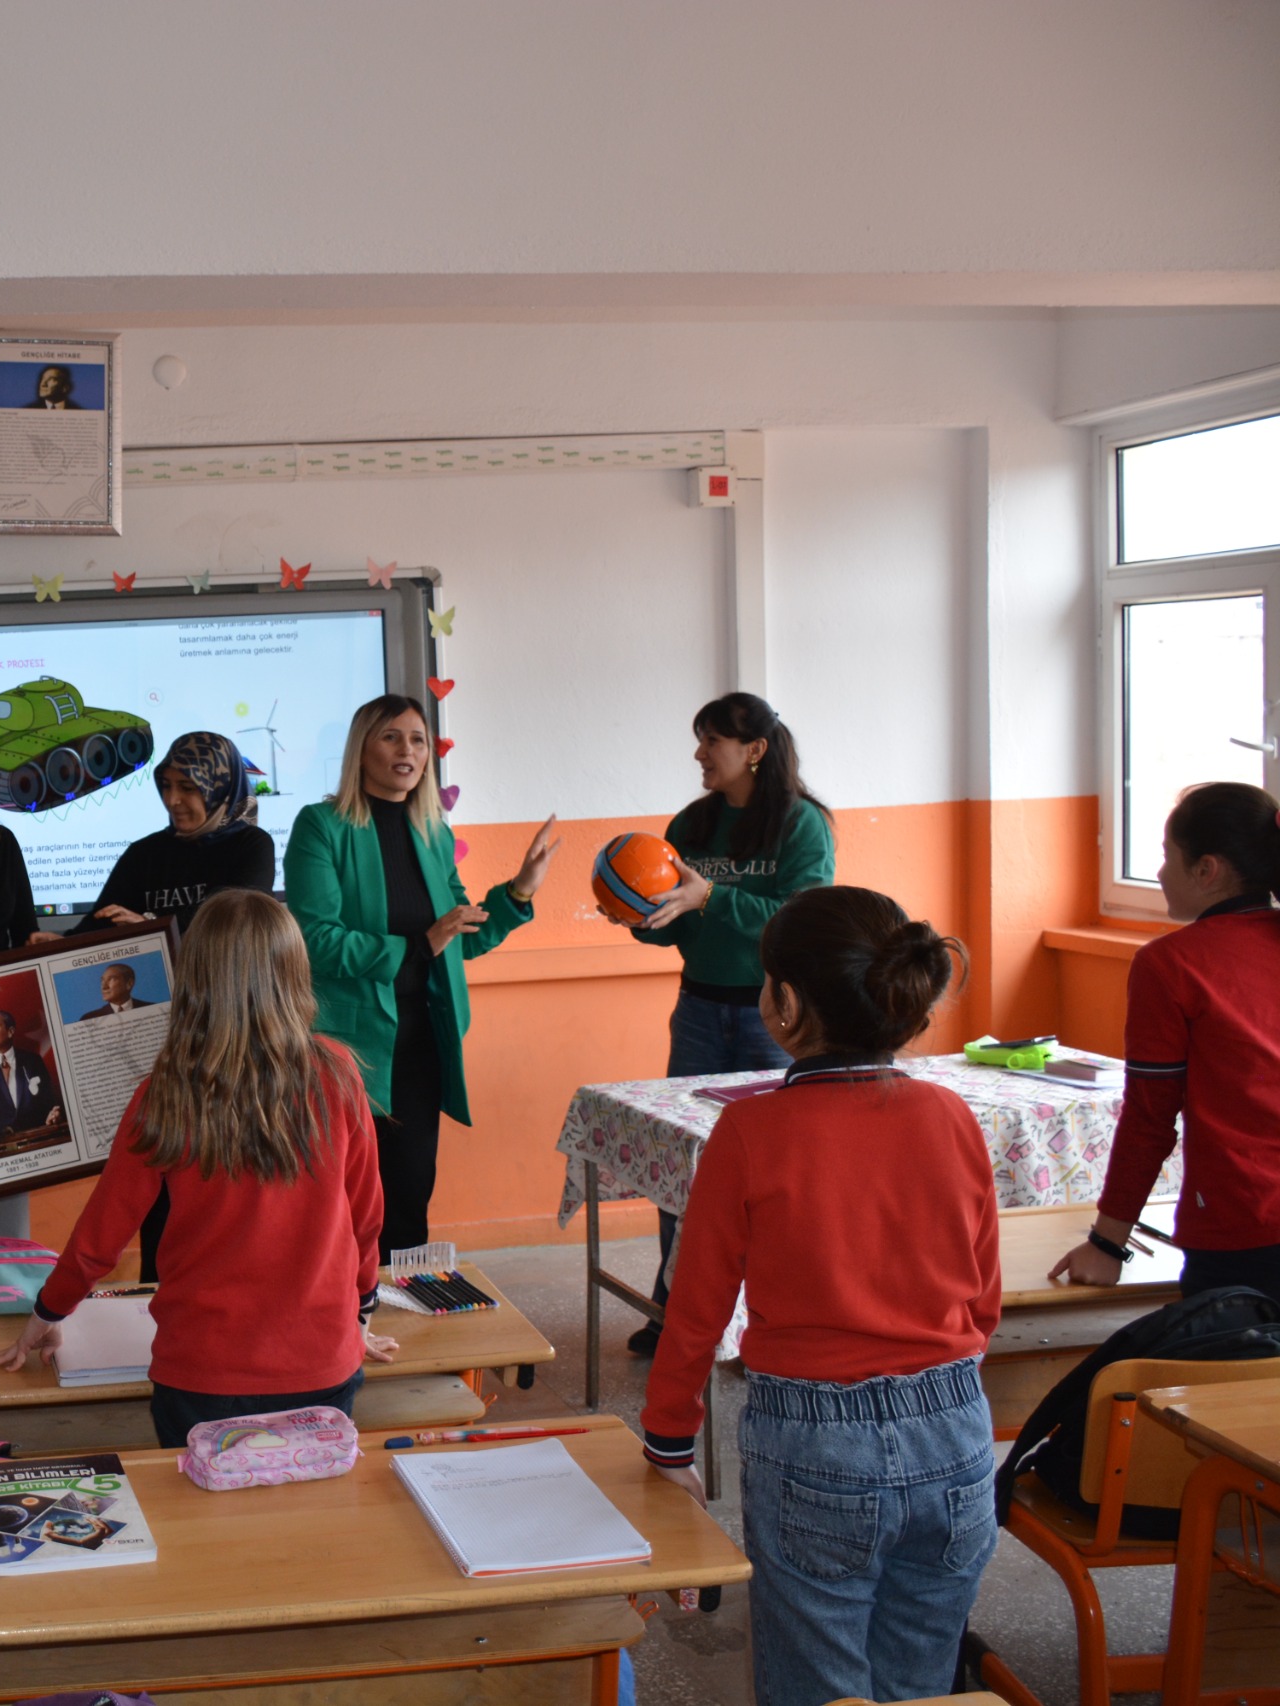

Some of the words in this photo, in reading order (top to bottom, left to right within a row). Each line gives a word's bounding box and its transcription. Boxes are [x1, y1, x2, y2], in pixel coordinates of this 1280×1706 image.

[236, 633, 256, 641] daha
[259, 632, 273, 642] çok
[276, 631, 298, 640] enerji
[180, 649, 212, 658] üretmek
[214, 647, 251, 656] anlamına
[254, 646, 294, 656] gelecektir.
[36, 843, 80, 853] araçlarının
[82, 840, 96, 849] her
[27, 857, 52, 866] edilen
[55, 855, 86, 865] paletler
[29, 870, 50, 879] daha
[52, 868, 71, 878] fazla
[73, 867, 105, 878] yüzeyle
[32, 881, 77, 891] tasarlamak
[154, 883, 207, 909] HAVE
[71, 951, 111, 968] GENÇLİĞE
[112, 945, 141, 958] HİTABE
[10, 1156, 33, 1166] KEMAL
[33, 1149, 63, 1161] ATATÜRK
[14, 1467, 96, 1481] BİLİMLERİ
[20, 1480, 66, 1490] KİTABI
[93, 1475, 122, 1491] 5
